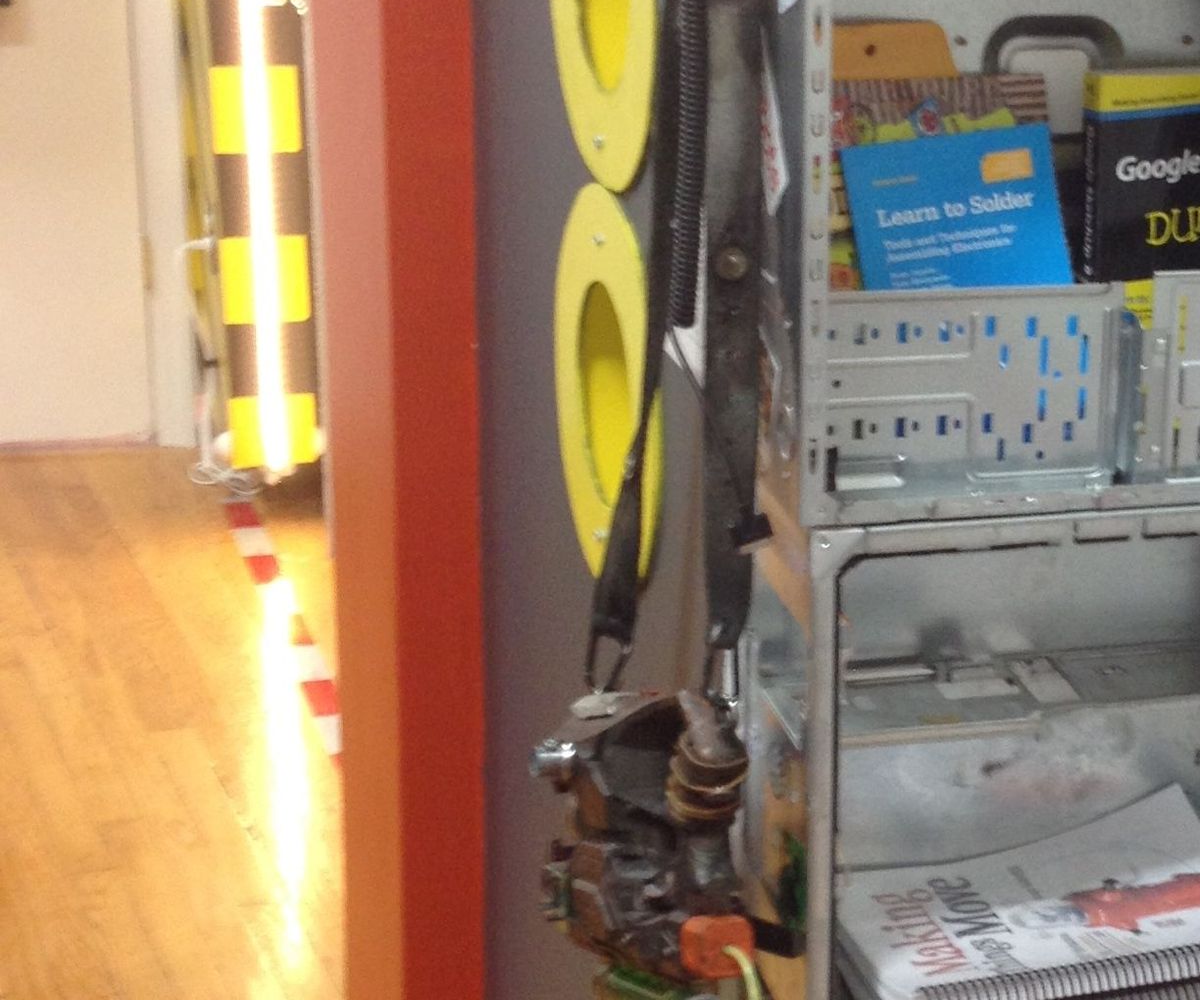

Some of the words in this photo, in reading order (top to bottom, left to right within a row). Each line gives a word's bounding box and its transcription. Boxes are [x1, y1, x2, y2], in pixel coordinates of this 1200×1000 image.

[875, 205, 942, 228] Learn
[943, 201, 968, 218] to
[968, 190, 1035, 215] Solder
[927, 876, 1013, 938] Move
